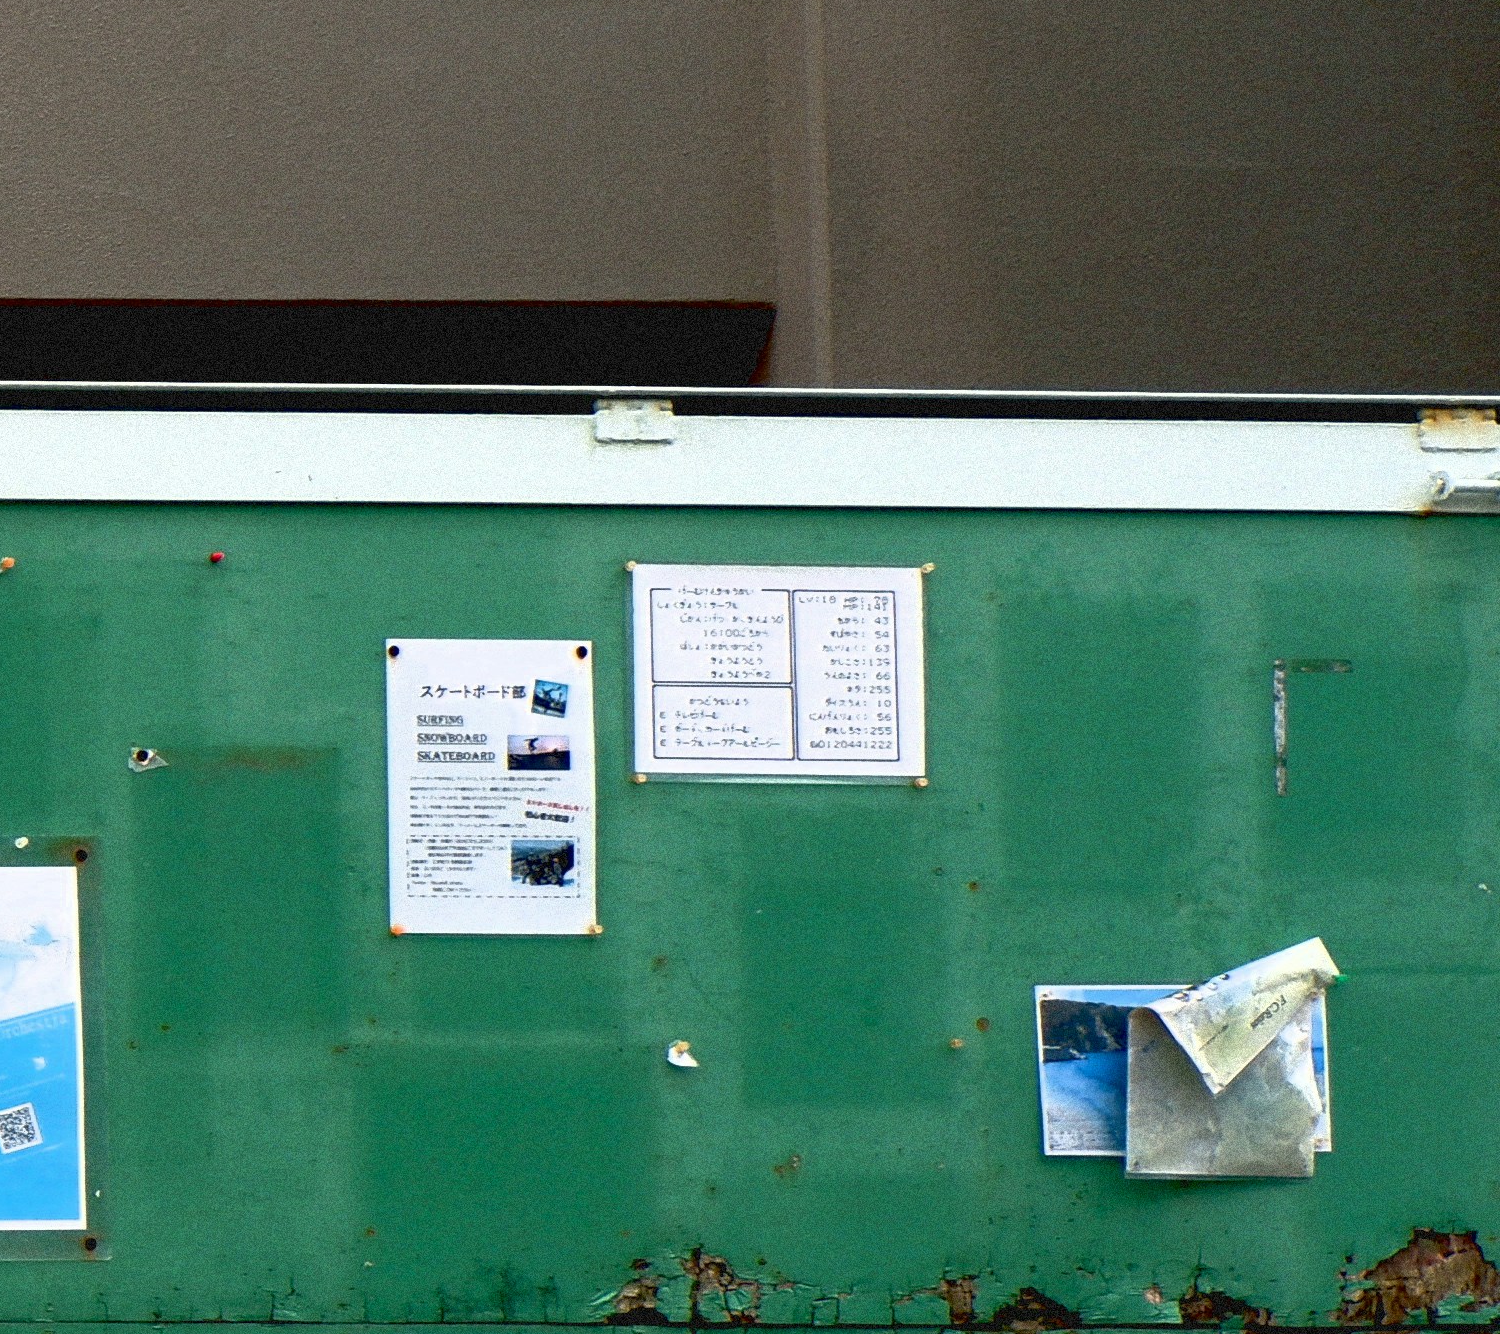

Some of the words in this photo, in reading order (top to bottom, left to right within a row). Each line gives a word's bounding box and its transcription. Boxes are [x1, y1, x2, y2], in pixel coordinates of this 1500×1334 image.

[419, 684, 527, 700] スケートボード部
[416, 715, 464, 726] SURFING
[416, 733, 488, 744] SNOWBOARD
[416, 751, 496, 762] SKATEBOARD
